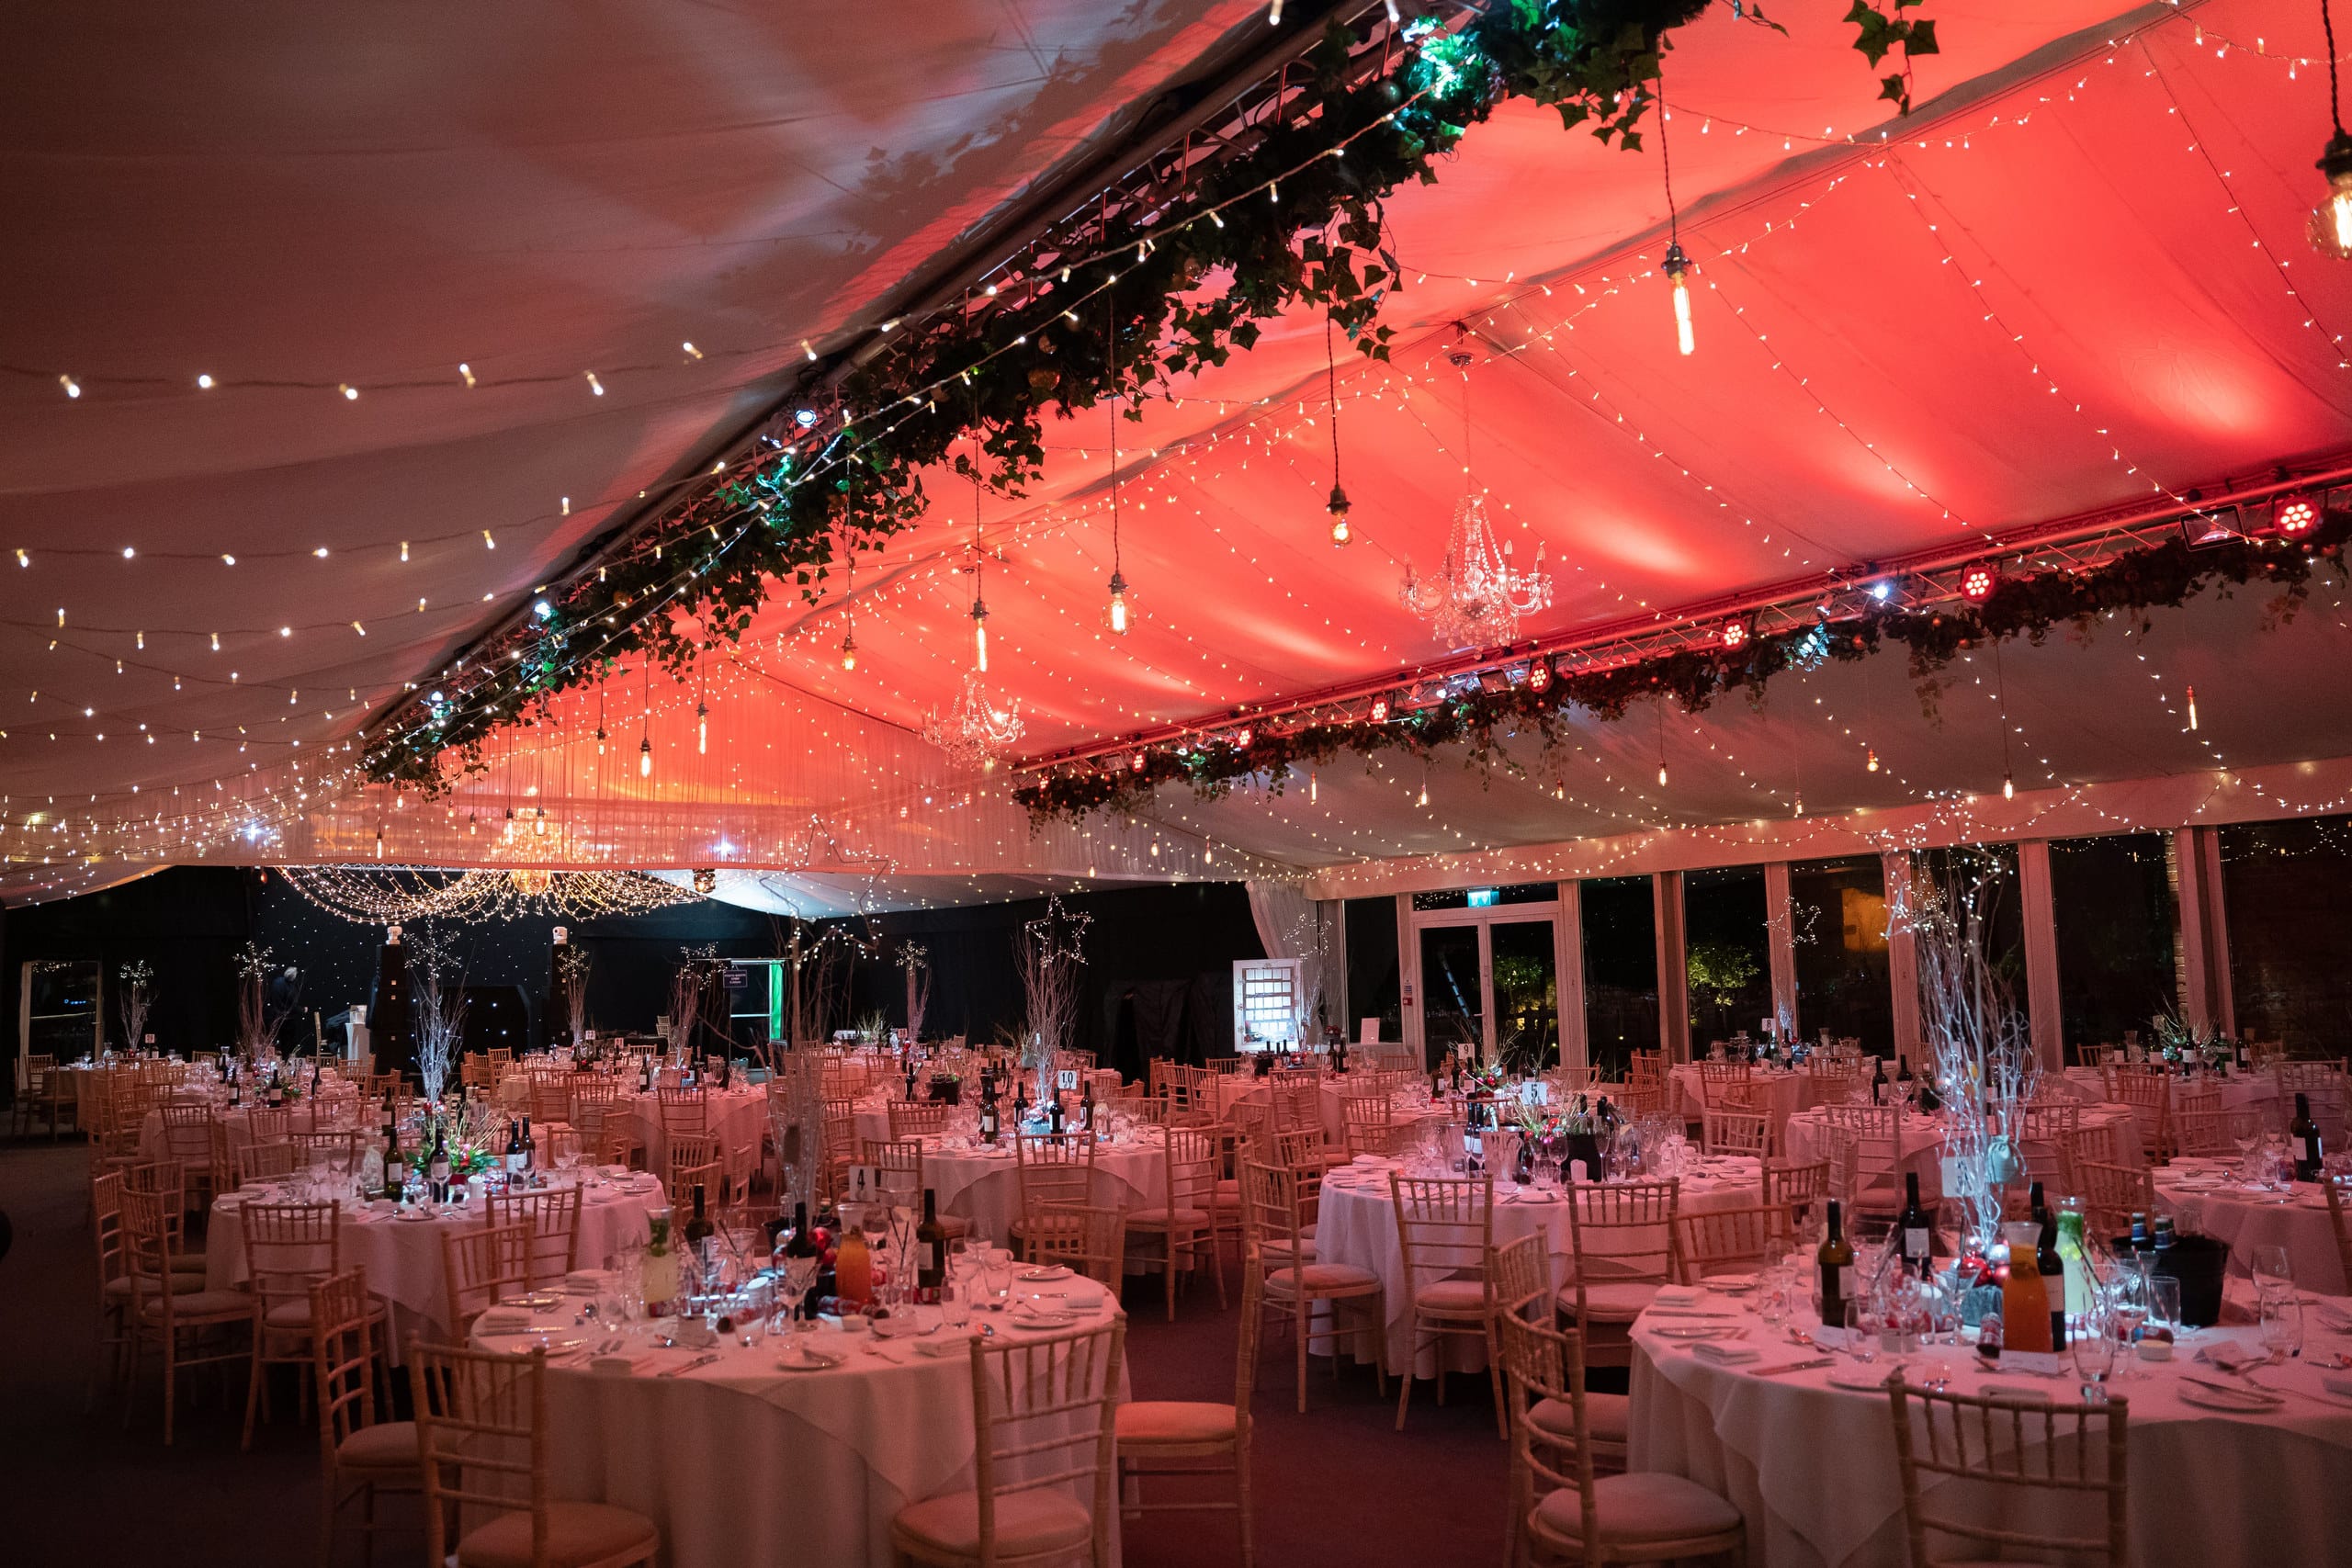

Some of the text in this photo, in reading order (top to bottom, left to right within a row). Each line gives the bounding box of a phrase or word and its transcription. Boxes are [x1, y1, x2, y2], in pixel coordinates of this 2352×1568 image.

[1062, 1071, 1074, 1084] 10
[1531, 1083, 1538, 1098] 5
[857, 1168, 865, 1191] 4
